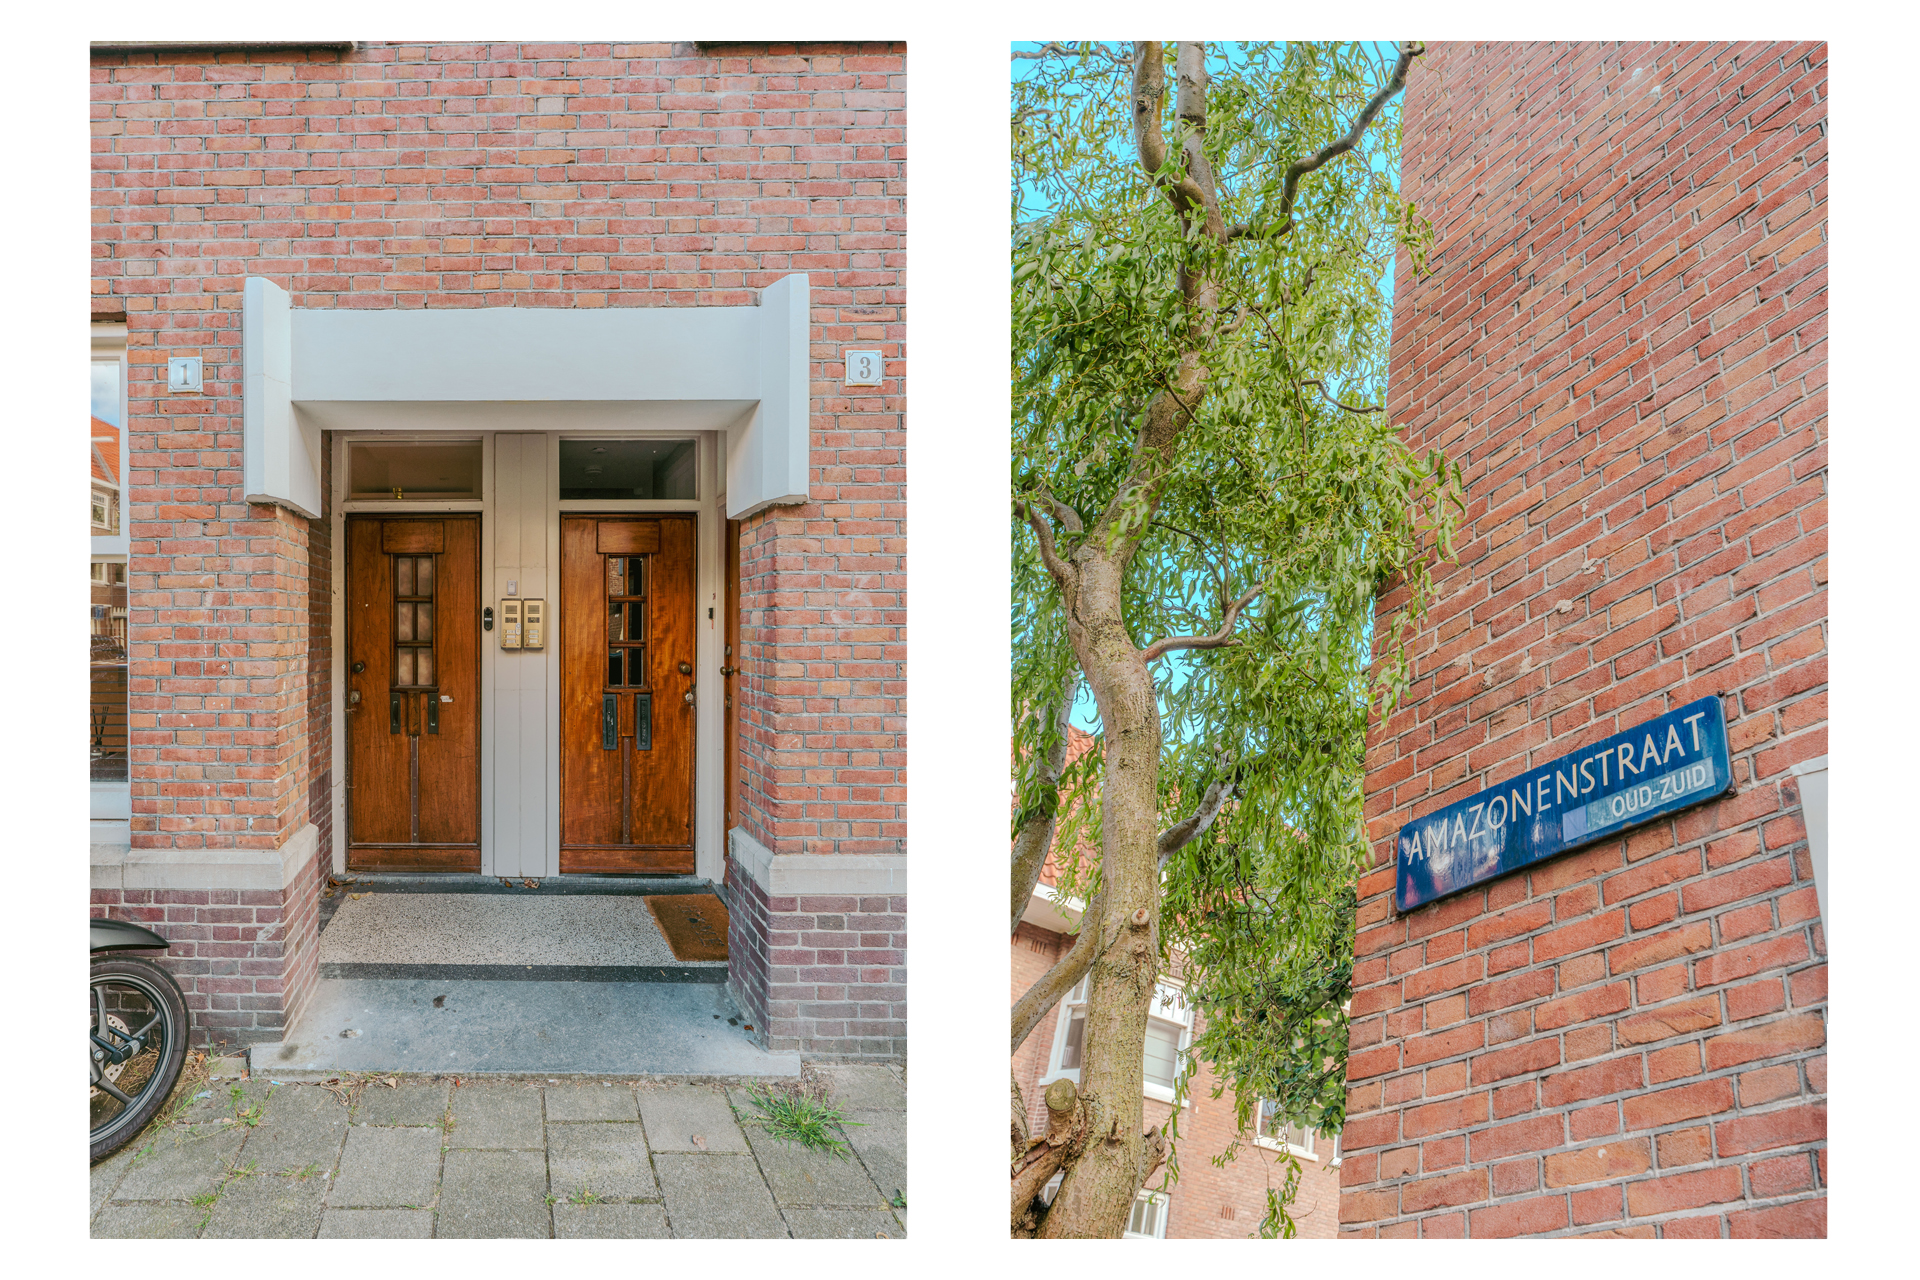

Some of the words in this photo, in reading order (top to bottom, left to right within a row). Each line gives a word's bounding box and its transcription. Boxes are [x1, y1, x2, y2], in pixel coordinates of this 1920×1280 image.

[181, 363, 190, 386] 1
[859, 356, 872, 379] 3
[1407, 711, 1706, 866] AMAZONENSTRAAT
[1611, 764, 1707, 818] OUD-ZUID
[92, 1112, 146, 1155] MICHELIN
